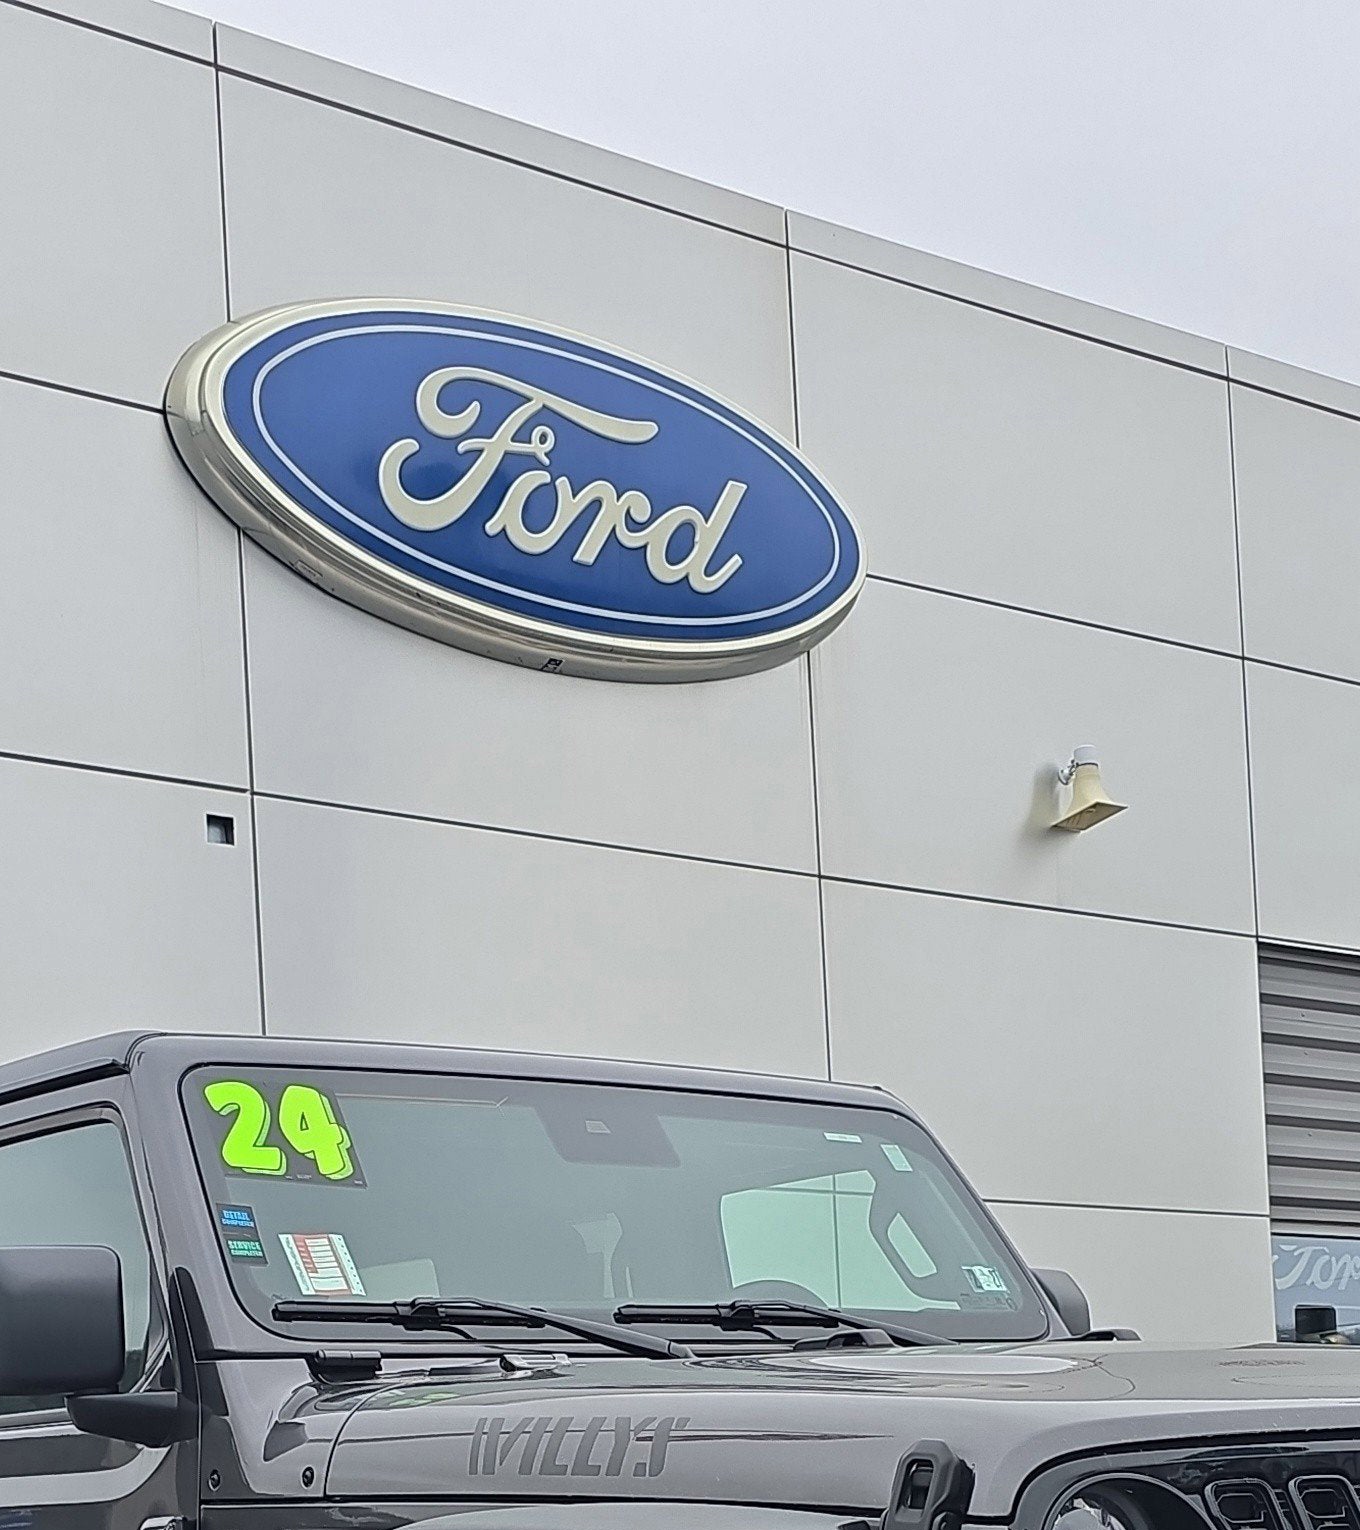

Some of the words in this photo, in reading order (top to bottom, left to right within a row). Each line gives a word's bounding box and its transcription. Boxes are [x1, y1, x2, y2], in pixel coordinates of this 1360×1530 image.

[379, 366, 747, 595] Ford
[204, 1081, 354, 1180] 24
[468, 1416, 690, 1477] WILLYS
